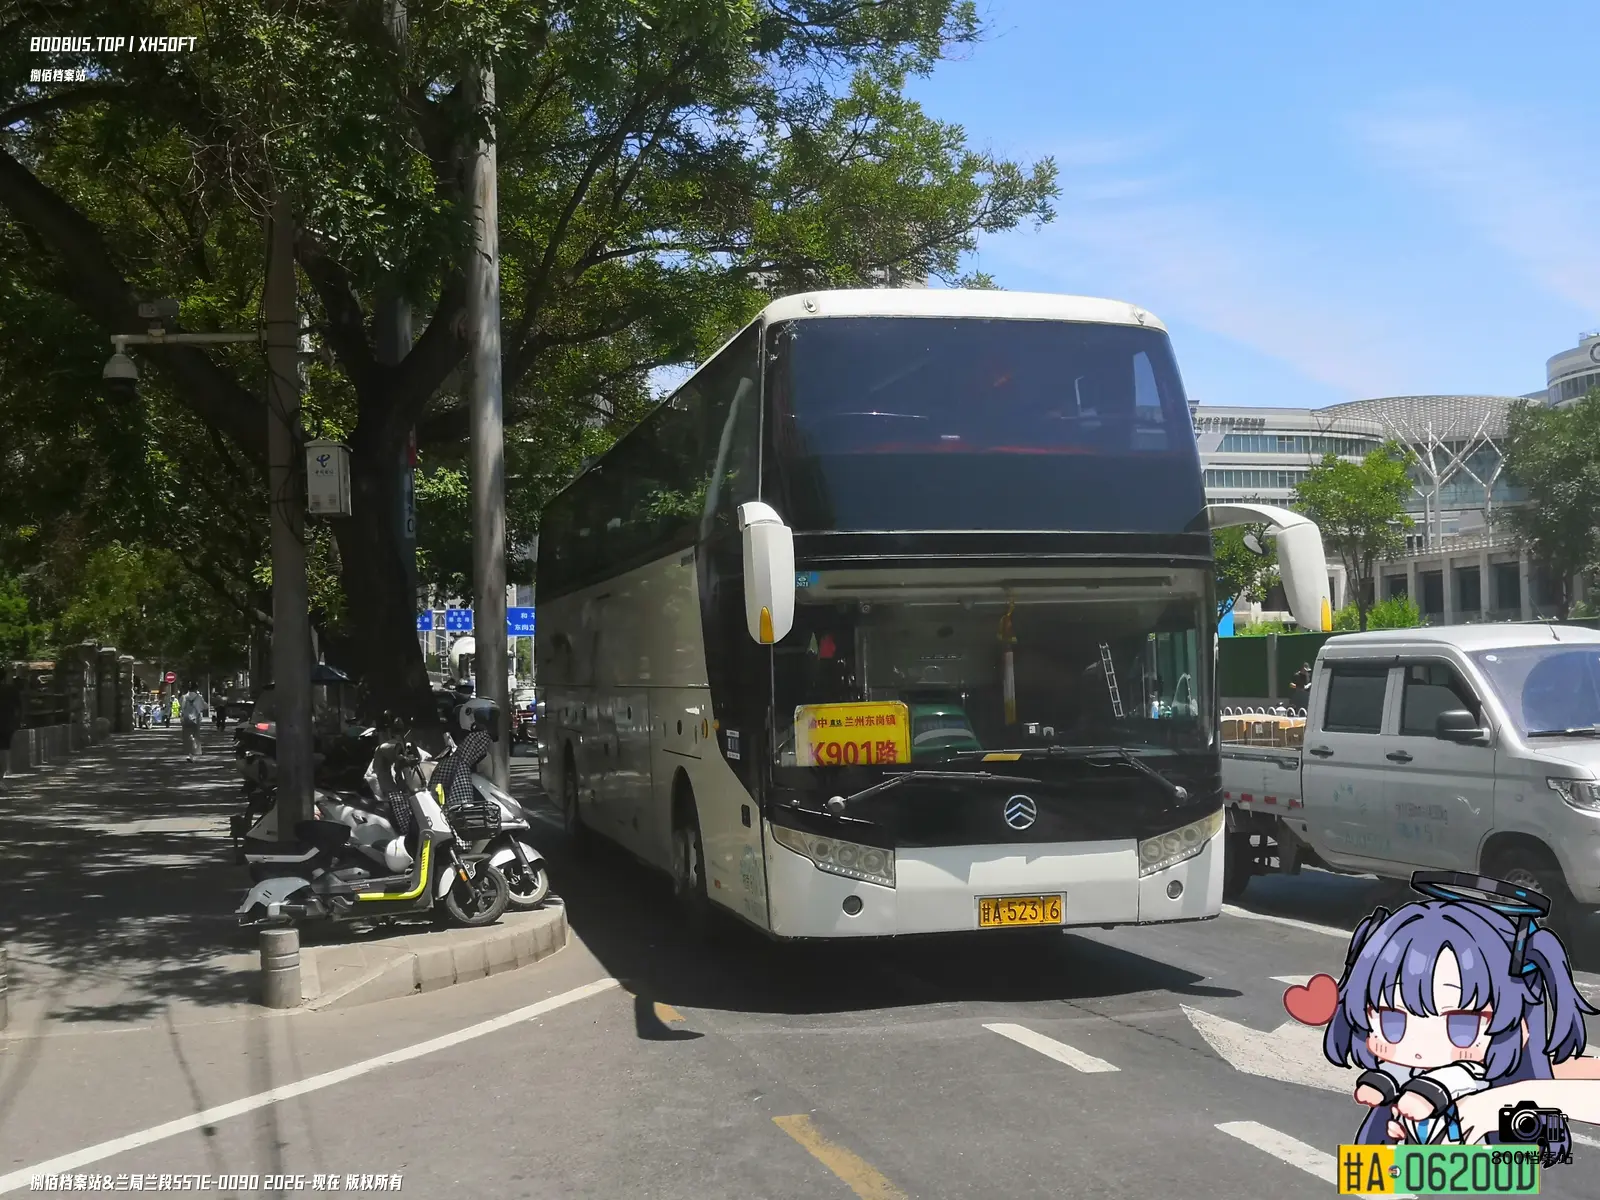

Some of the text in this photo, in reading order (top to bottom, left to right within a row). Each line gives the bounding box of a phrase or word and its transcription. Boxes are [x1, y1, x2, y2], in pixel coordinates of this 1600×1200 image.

[845, 714, 897, 728] 兰州东岗镇
[808, 740, 899, 767] K901路
